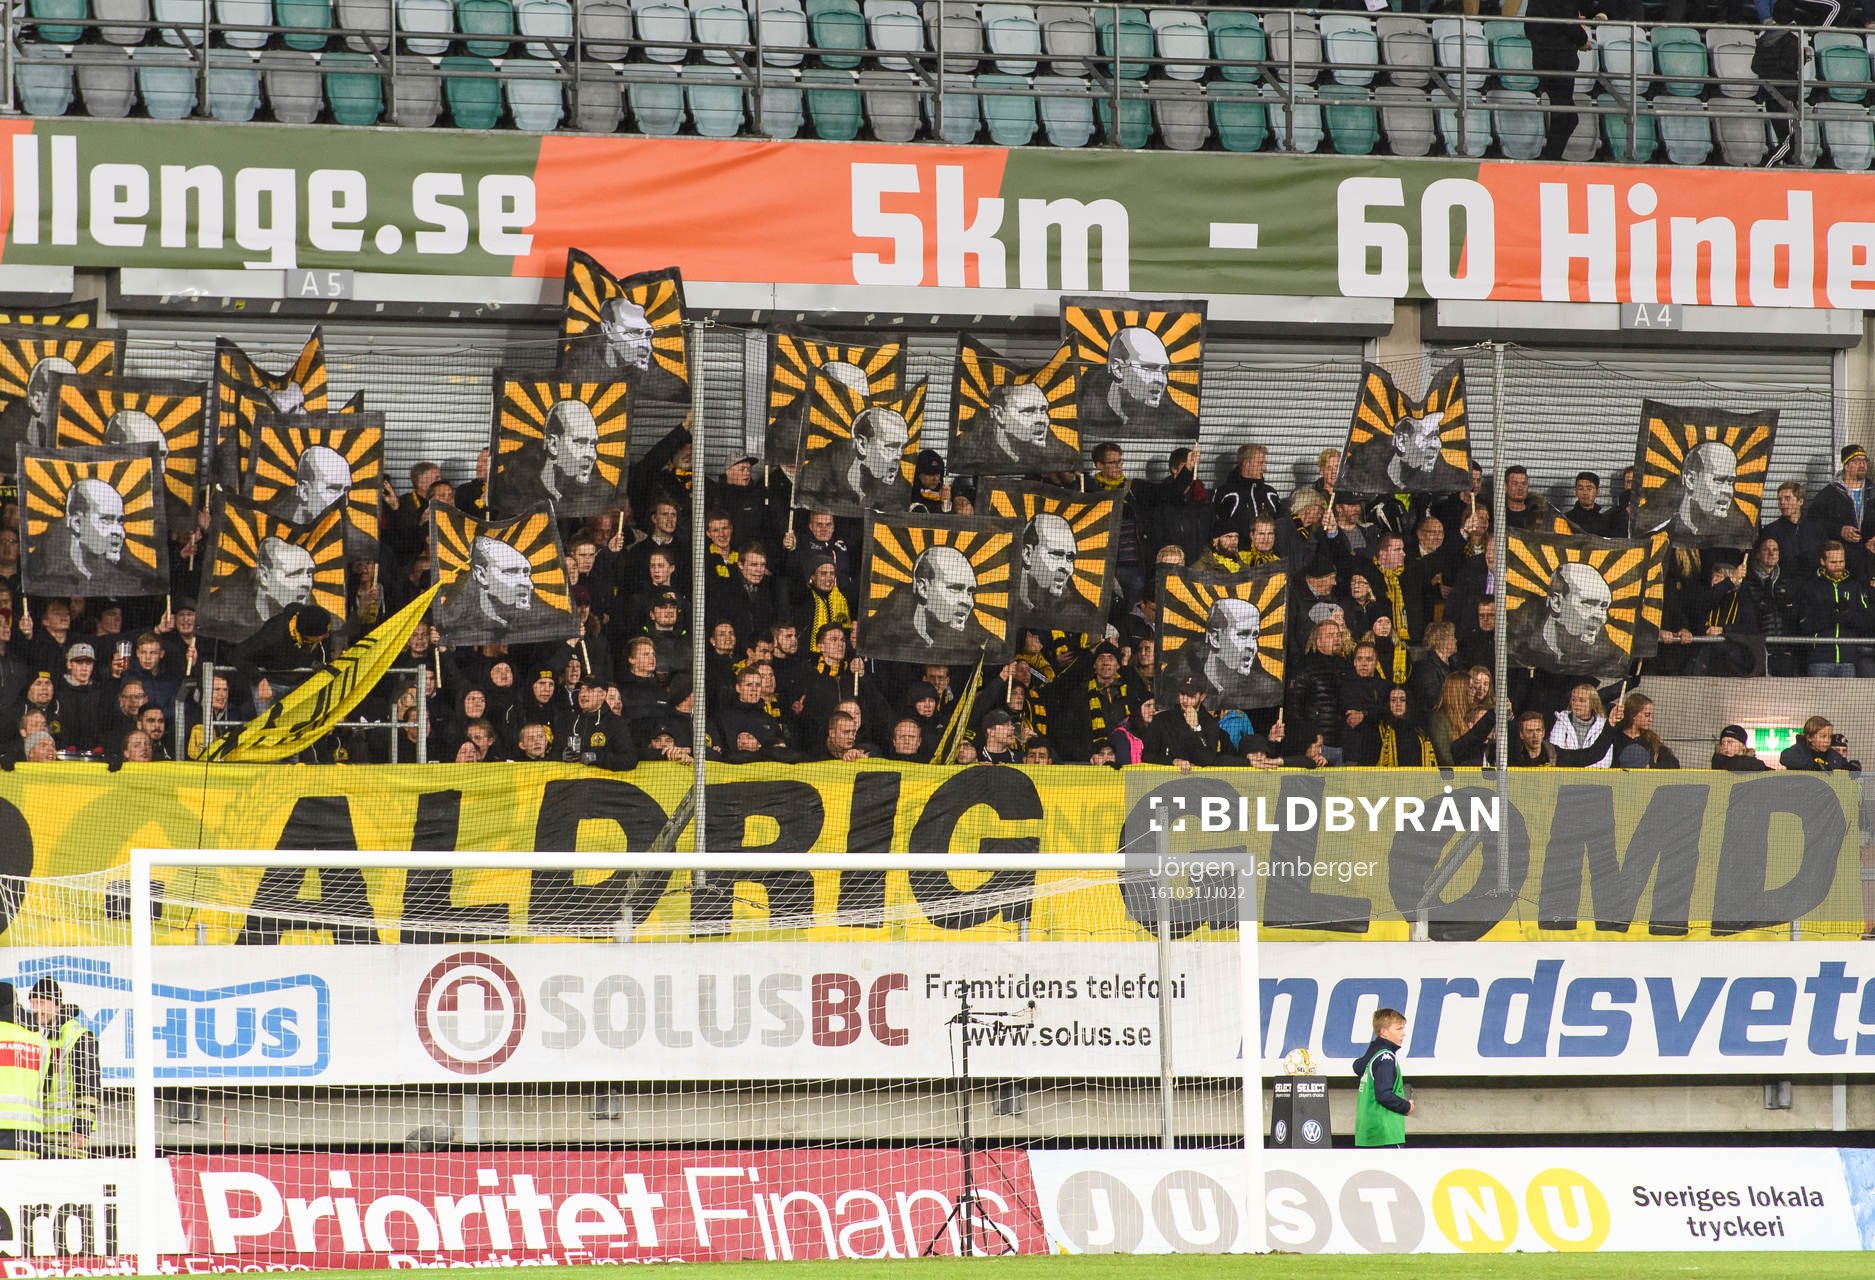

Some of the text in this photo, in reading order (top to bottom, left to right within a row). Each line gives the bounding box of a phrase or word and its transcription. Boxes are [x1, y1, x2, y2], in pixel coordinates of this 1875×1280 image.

[12, 134, 537, 270] llenge.se
[851, 162, 1130, 291] 5km
[1337, 177, 1495, 300] 60
[1539, 182, 1875, 309] Hinde
[301, 271, 341, 297] A 5
[1634, 303, 1672, 328] A 4
[236, 765, 1044, 945] ALDRIG
[926, 973, 1078, 999] Framtidens
[1237, 959, 1875, 1058] nordsvet
[966, 1020, 1152, 1047] www.solus.se
[1296, 1083, 1325, 1093] SELECT
[1632, 1186, 1825, 1212] Sveriges lokala
[199, 1167, 1018, 1260] Prioritet Finans
[1687, 1216, 1785, 1242] tryckeri
